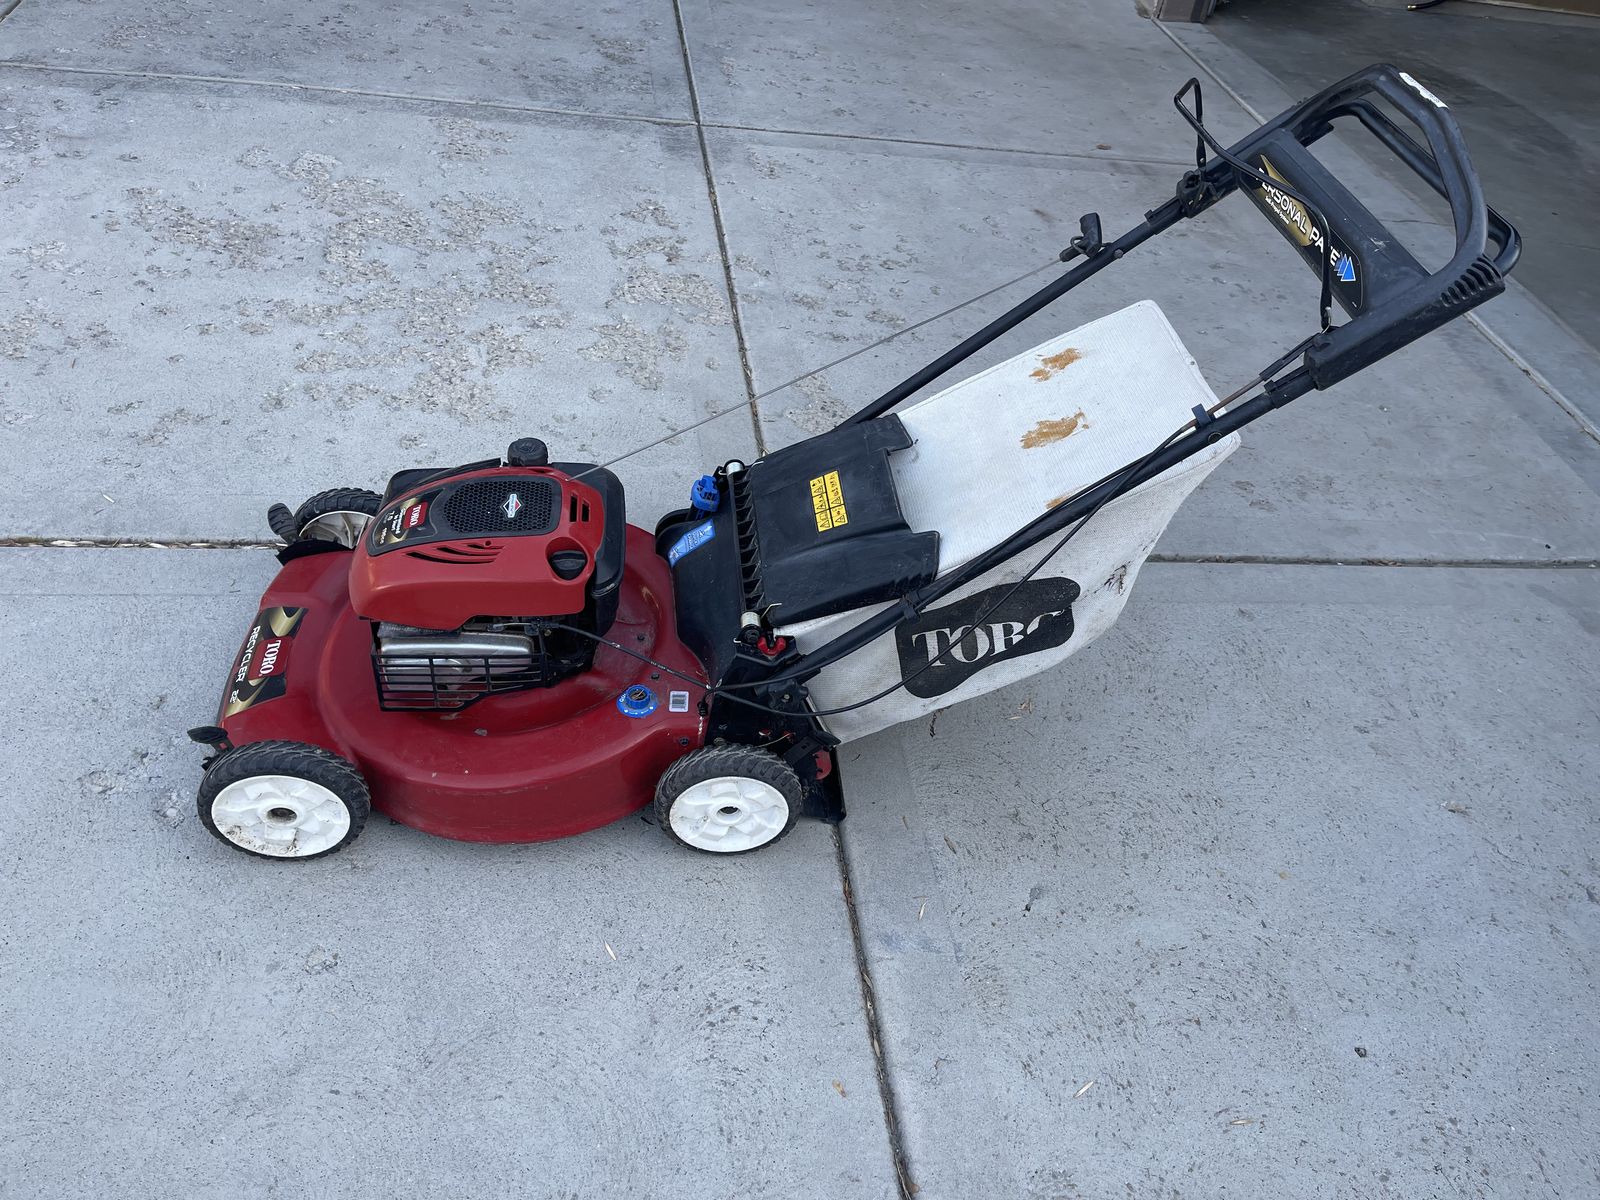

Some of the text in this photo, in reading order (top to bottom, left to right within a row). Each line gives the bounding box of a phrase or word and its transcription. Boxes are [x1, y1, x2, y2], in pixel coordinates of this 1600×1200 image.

[1310, 227, 1340, 266] PAE
[410, 505, 421, 526] TORO
[235, 625, 261, 682] RECYCLER
[260, 640, 281, 675] TORO
